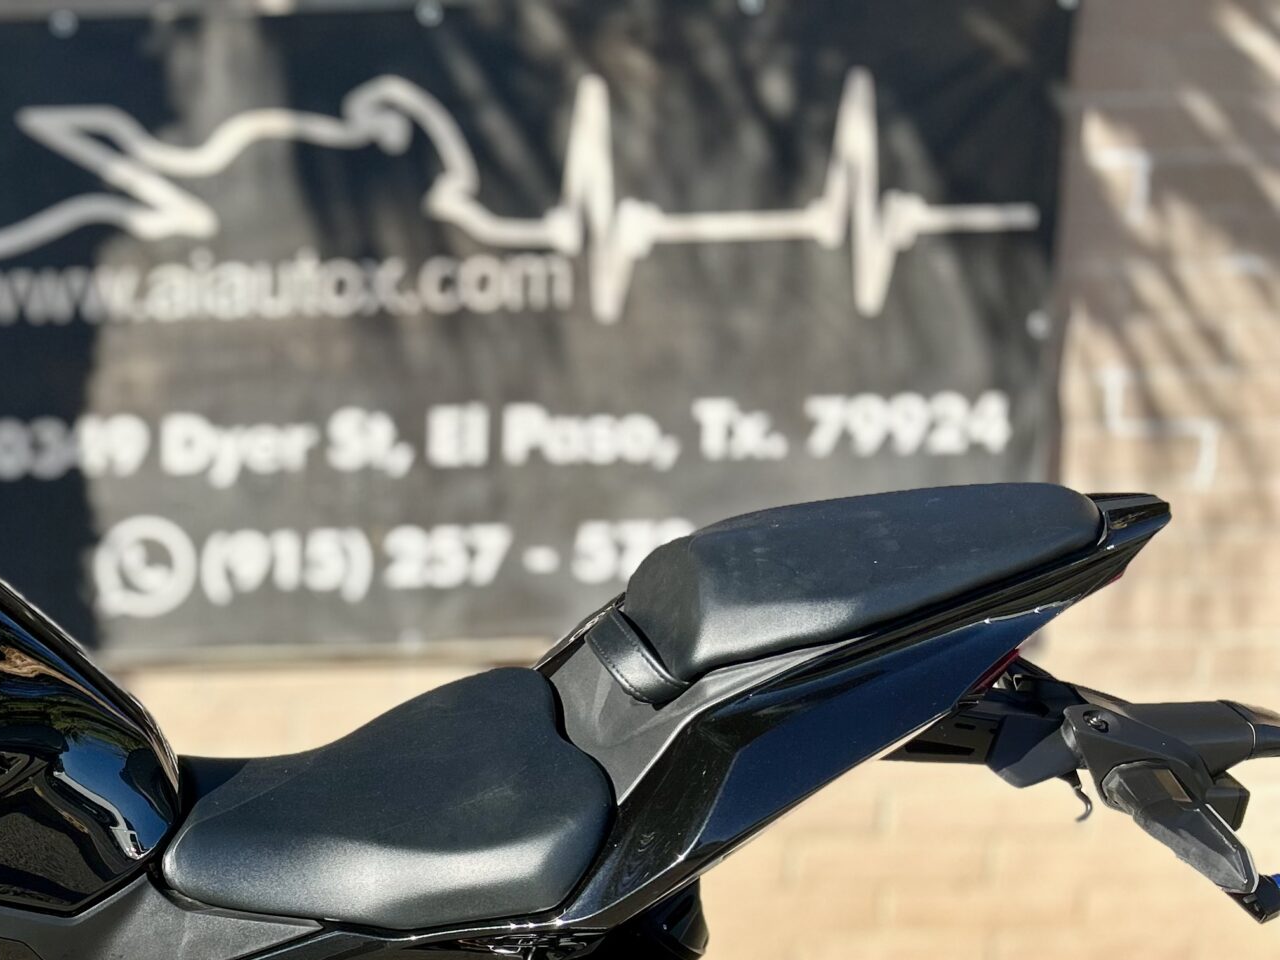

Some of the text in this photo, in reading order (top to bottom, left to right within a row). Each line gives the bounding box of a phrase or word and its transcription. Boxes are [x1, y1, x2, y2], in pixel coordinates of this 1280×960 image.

[158, 411, 320, 488] Dyer
[326, 405, 415, 479] St,
[426, 401, 490, 468] El
[502, 402, 680, 472] Paso,
[804, 390, 1011, 458] 79924
[201, 527, 373, 605] (915)
[383, 521, 513, 589] 257
